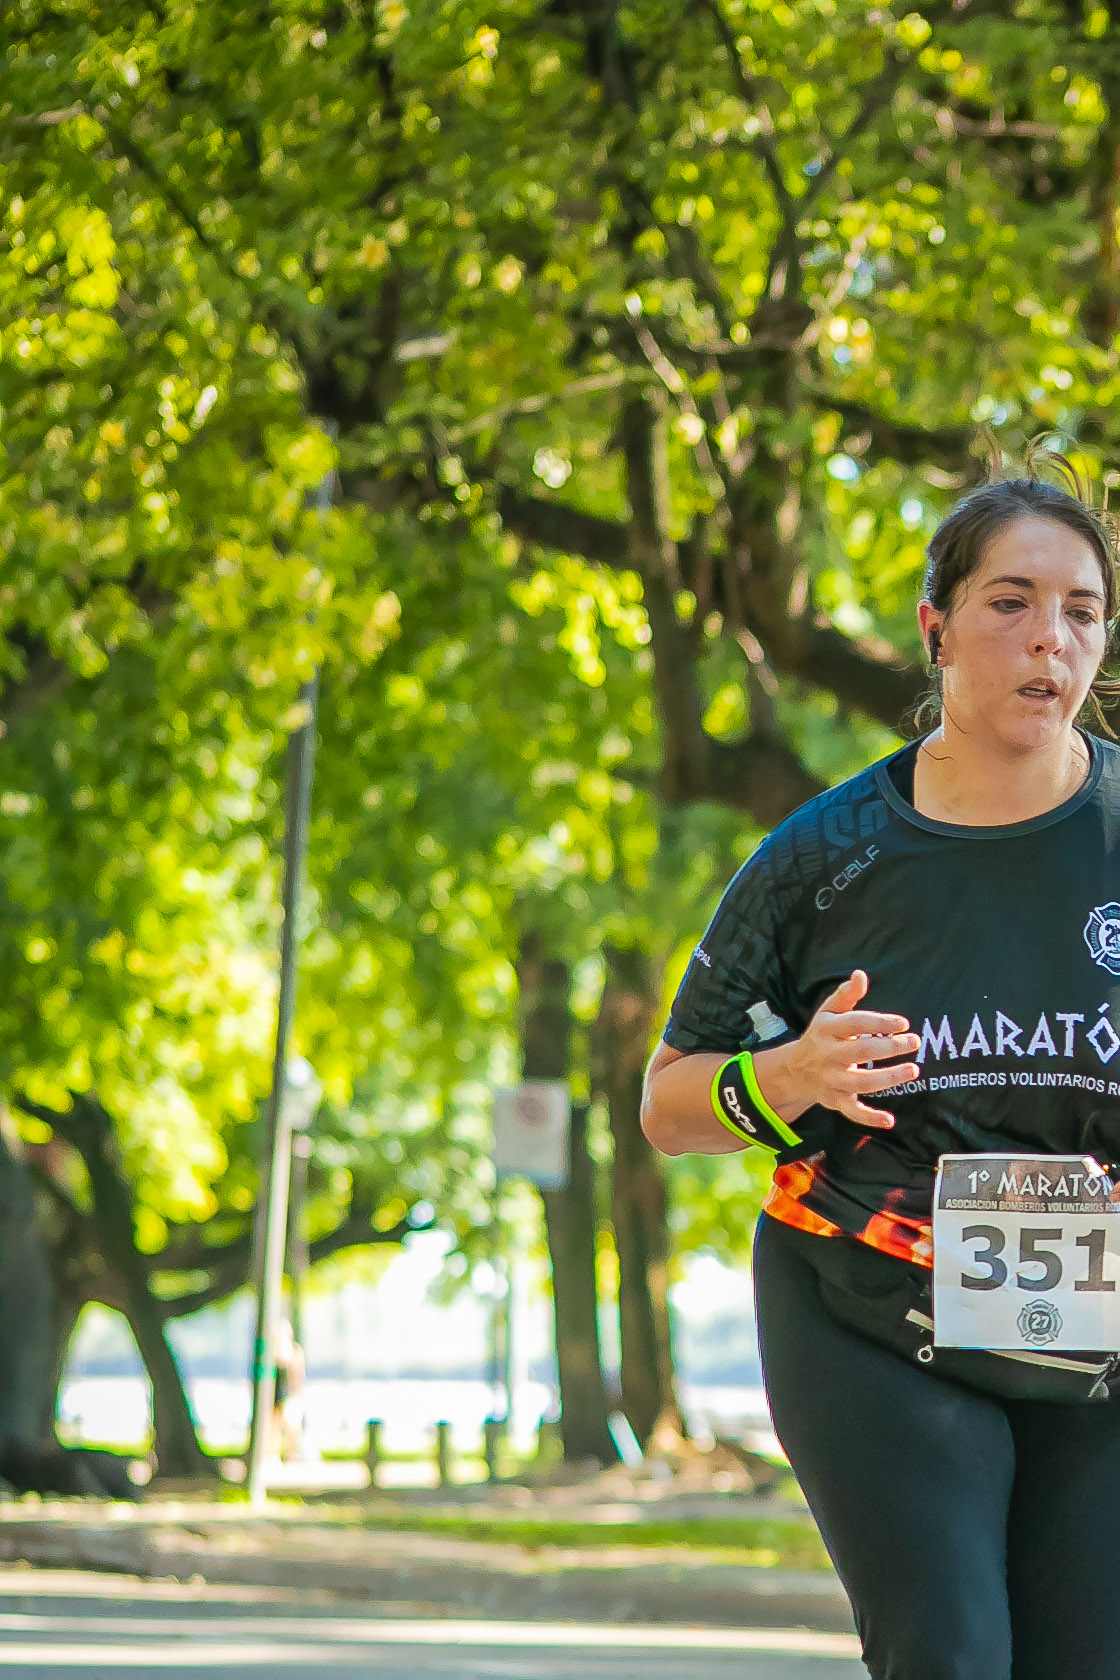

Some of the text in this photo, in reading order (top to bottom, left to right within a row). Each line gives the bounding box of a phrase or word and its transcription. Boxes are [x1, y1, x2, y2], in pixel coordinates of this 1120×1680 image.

[929, 1072, 1007, 1091] BOMBEROS
[1010, 1072, 1106, 1093] VOLUNTARIOS
[999, 1201, 1046, 1212] BOMBEROS
[1047, 1202, 1104, 1213] VOLUNTARIOS
[961, 1224, 1116, 1292] 351
[1031, 1313, 1050, 1330] 27
